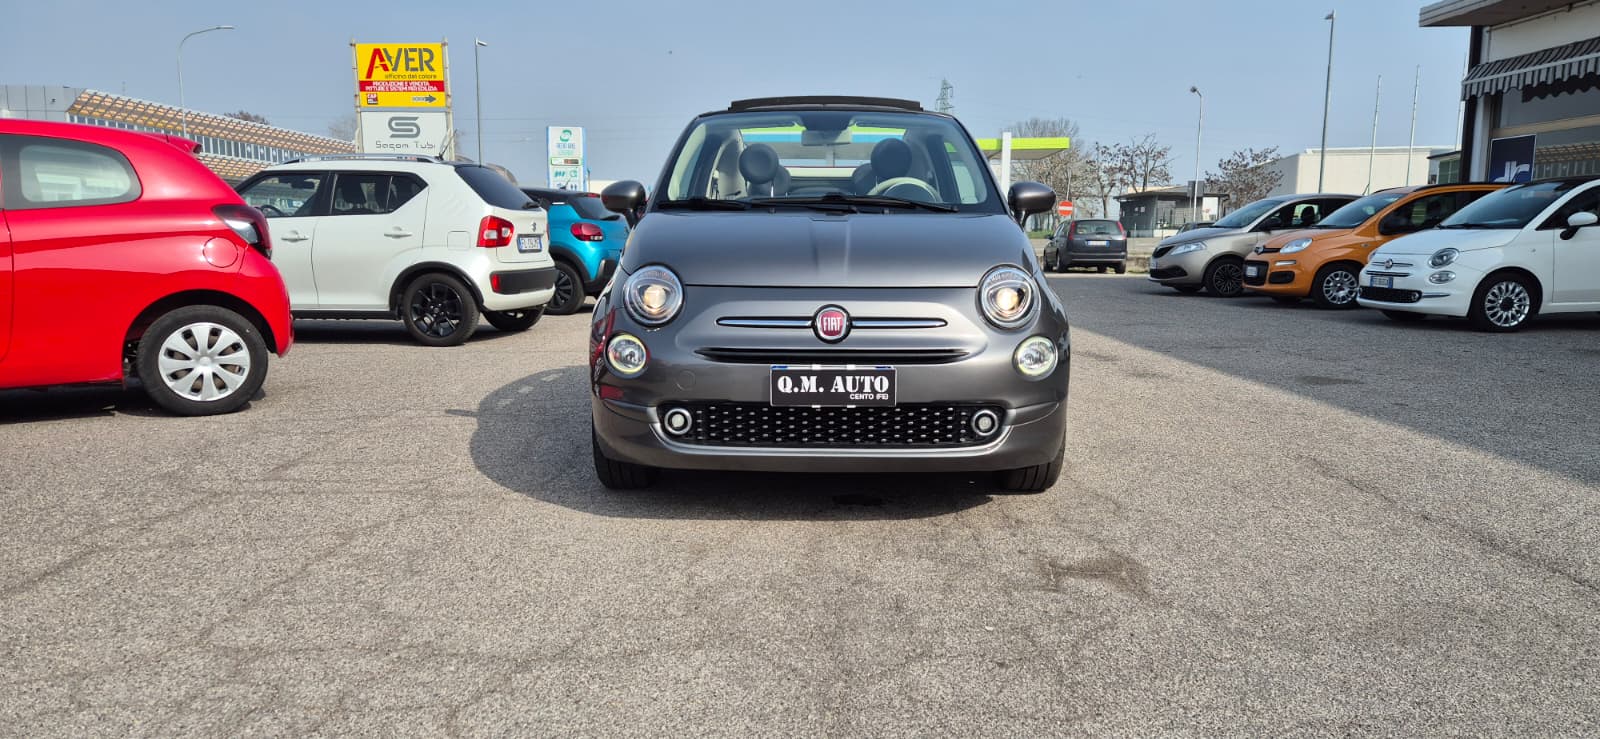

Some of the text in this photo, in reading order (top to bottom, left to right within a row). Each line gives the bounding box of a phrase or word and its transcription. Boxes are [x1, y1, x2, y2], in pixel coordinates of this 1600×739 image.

[365, 47, 435, 79] AVER
[822, 316, 842, 332] FIAT
[777, 375, 889, 393] Q.M. AUTO
